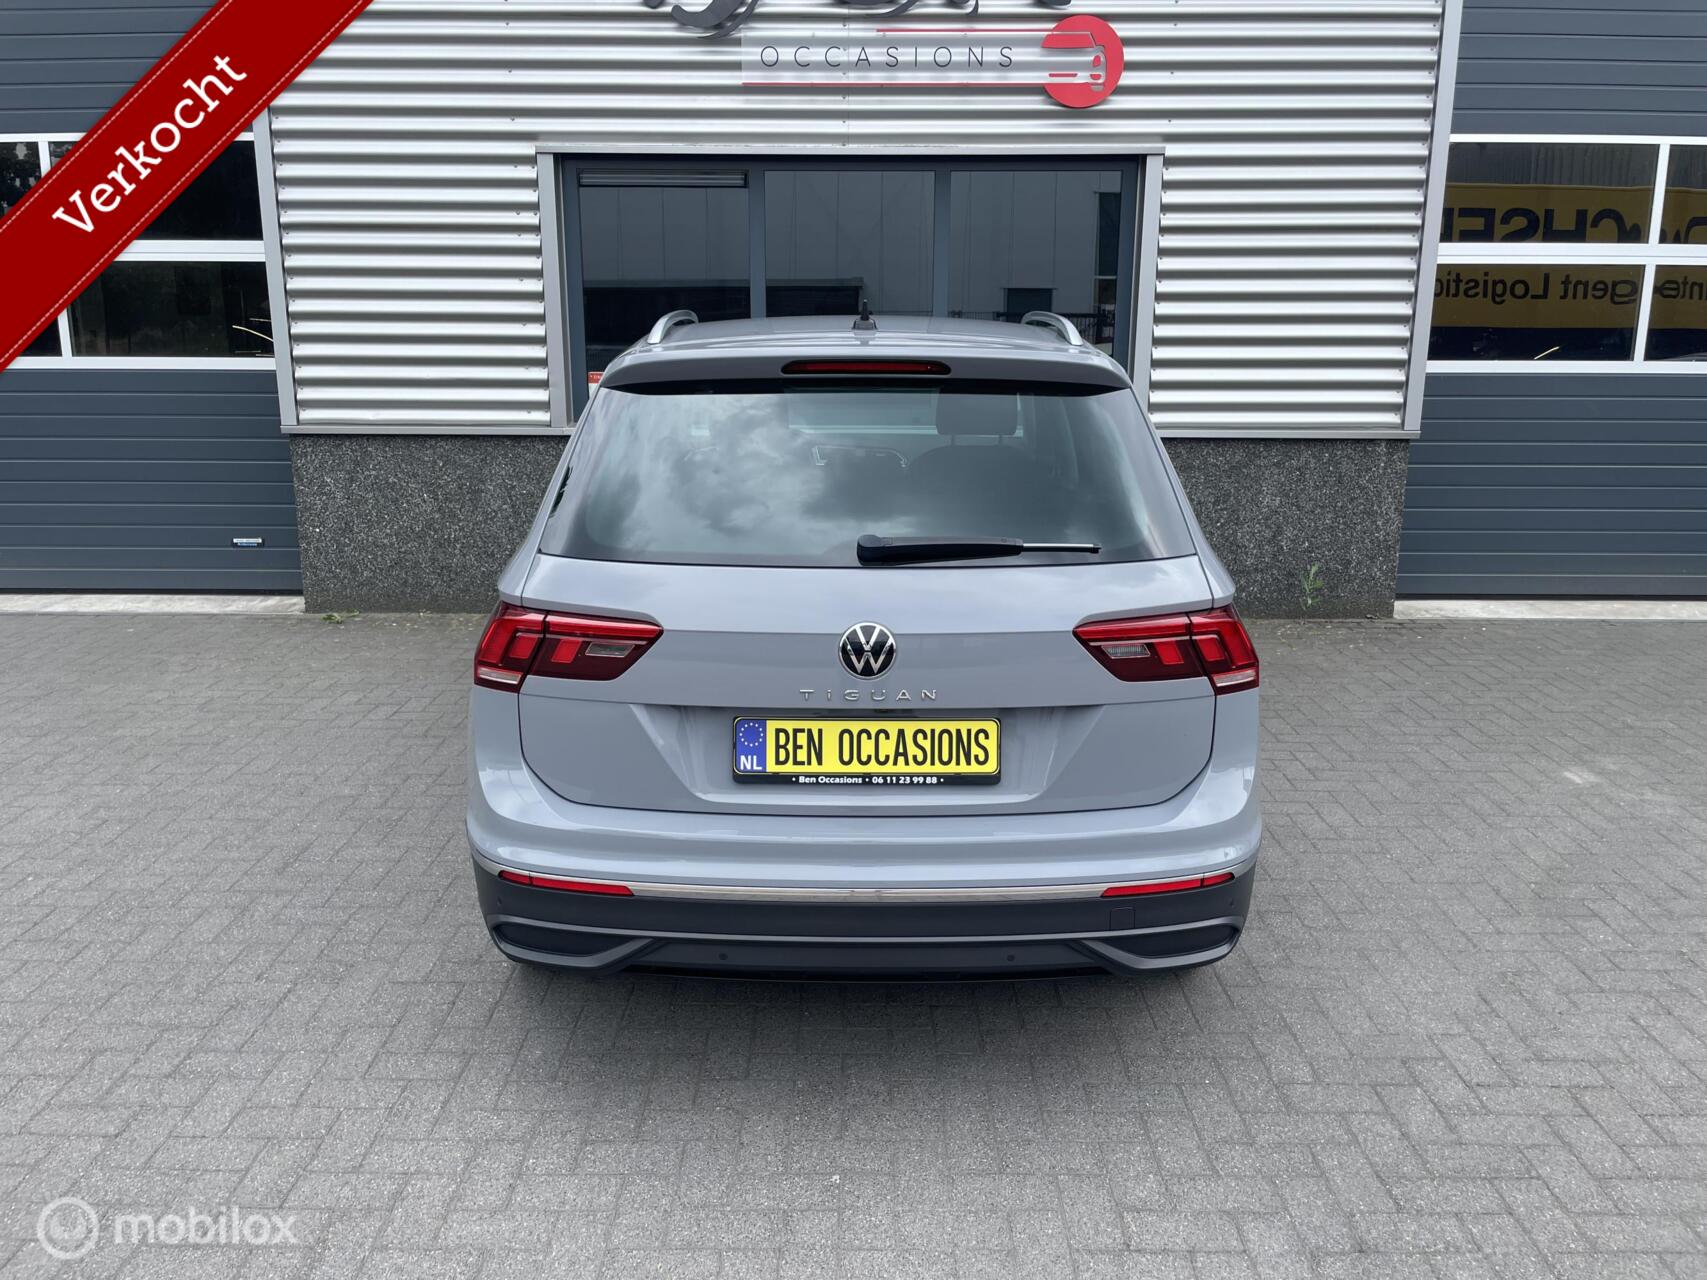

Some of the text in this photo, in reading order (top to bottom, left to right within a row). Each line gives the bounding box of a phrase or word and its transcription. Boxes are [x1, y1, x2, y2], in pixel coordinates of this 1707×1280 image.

[760, 46, 1014, 68] OCCASIONS
[800, 688, 938, 701] TIGUAN
[775, 728, 990, 767] BEN OCCASIONS
[740, 755, 763, 771] NL
[818, 776, 862, 784] Occasions
[872, 776, 883, 784] 06
[886, 776, 896, 784] 11
[899, 776, 910, 784] 23
[913, 776, 924, 784] 99
[926, 776, 937, 784] 88
